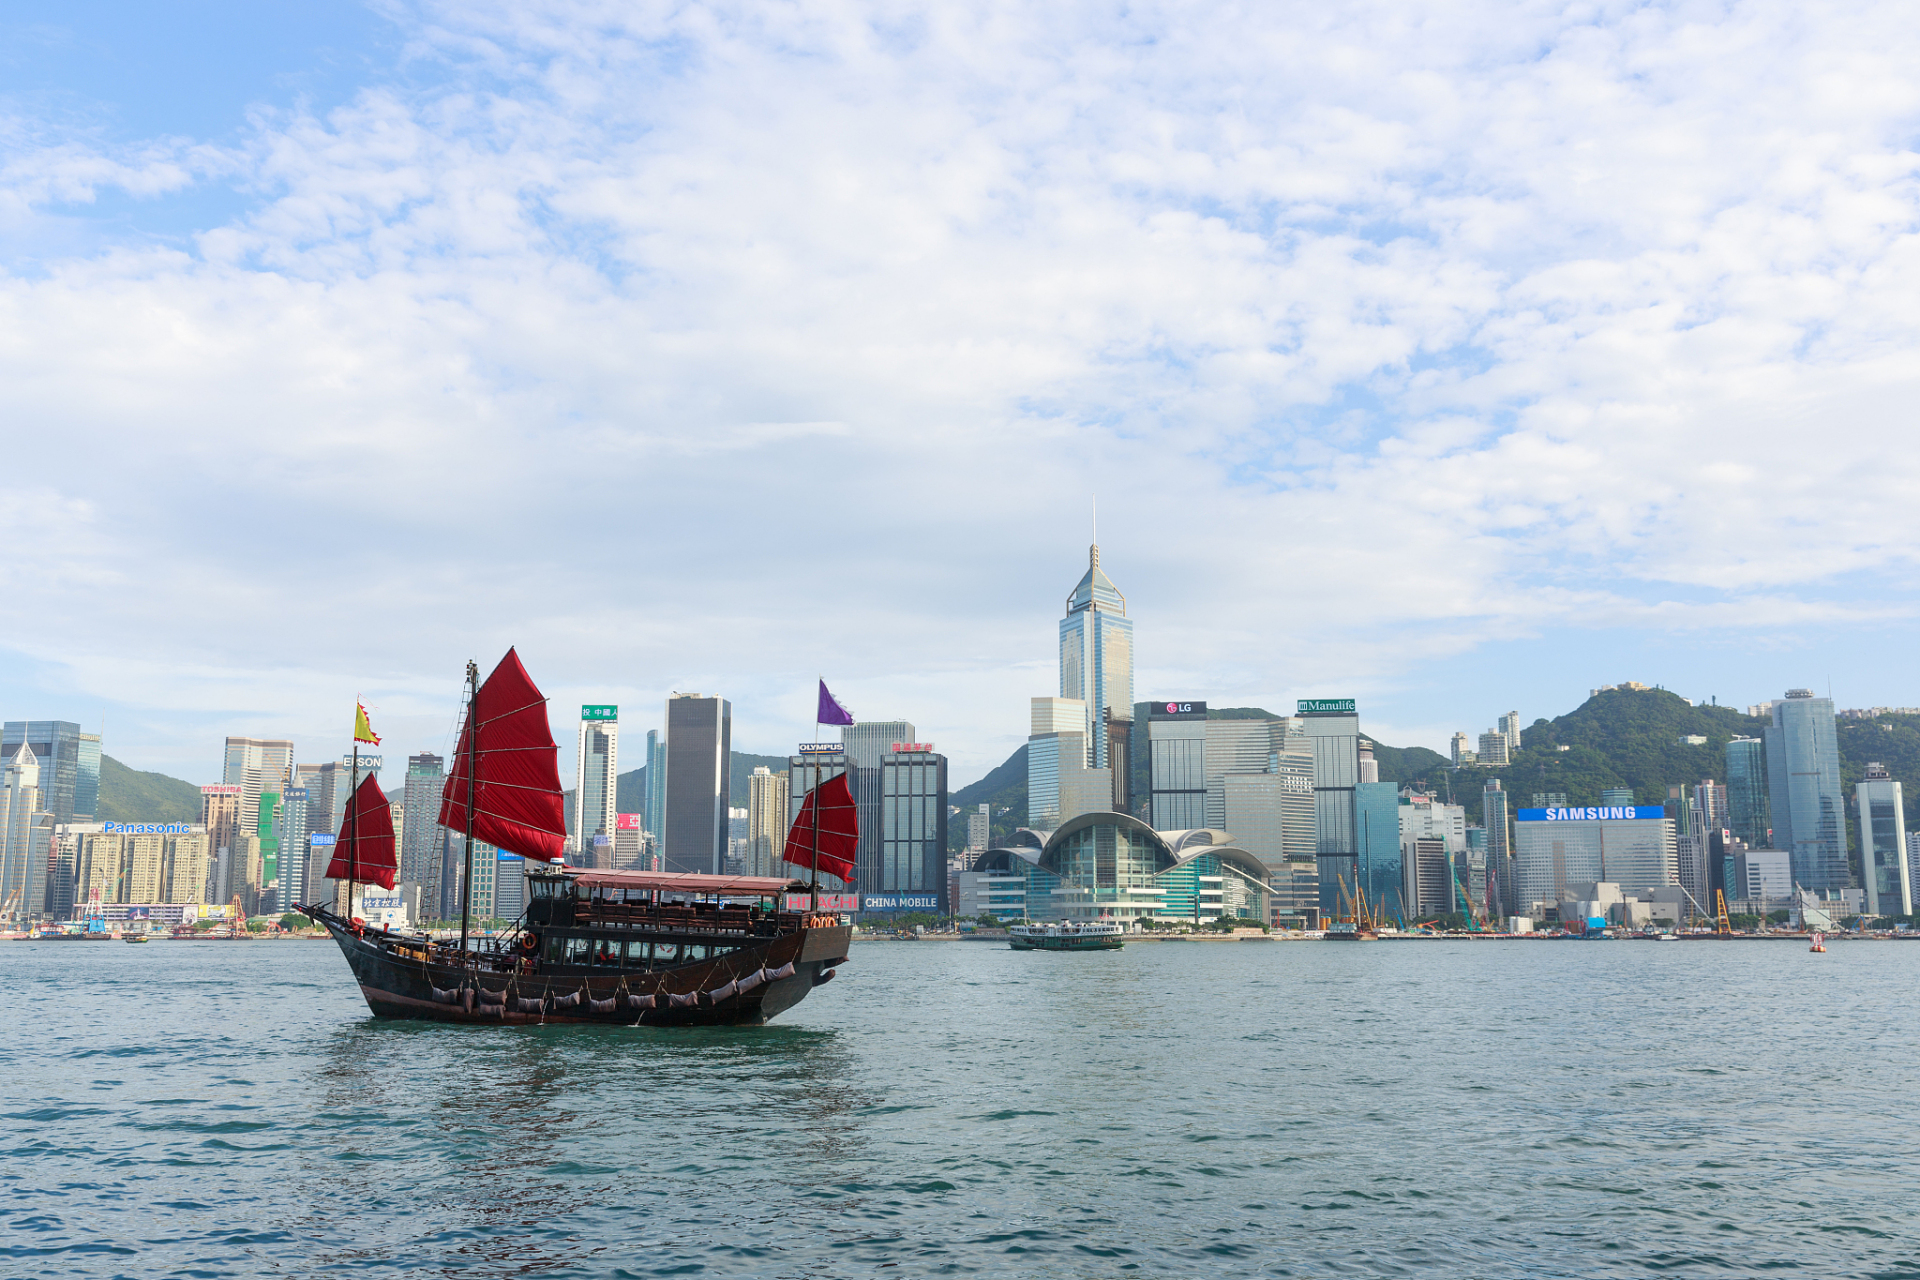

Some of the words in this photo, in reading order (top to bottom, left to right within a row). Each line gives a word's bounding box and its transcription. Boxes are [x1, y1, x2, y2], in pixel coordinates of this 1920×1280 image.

[1178, 703, 1192, 712] LG
[1308, 700, 1355, 711] Manulife
[799, 743, 844, 751] OLYMPUS
[343, 757, 381, 767] ESON
[1545, 806, 1636, 821] SAMSUNG
[104, 821, 190, 834] Panasonic
[865, 897, 897, 908] CHINA
[899, 897, 937, 908] MOBILE
